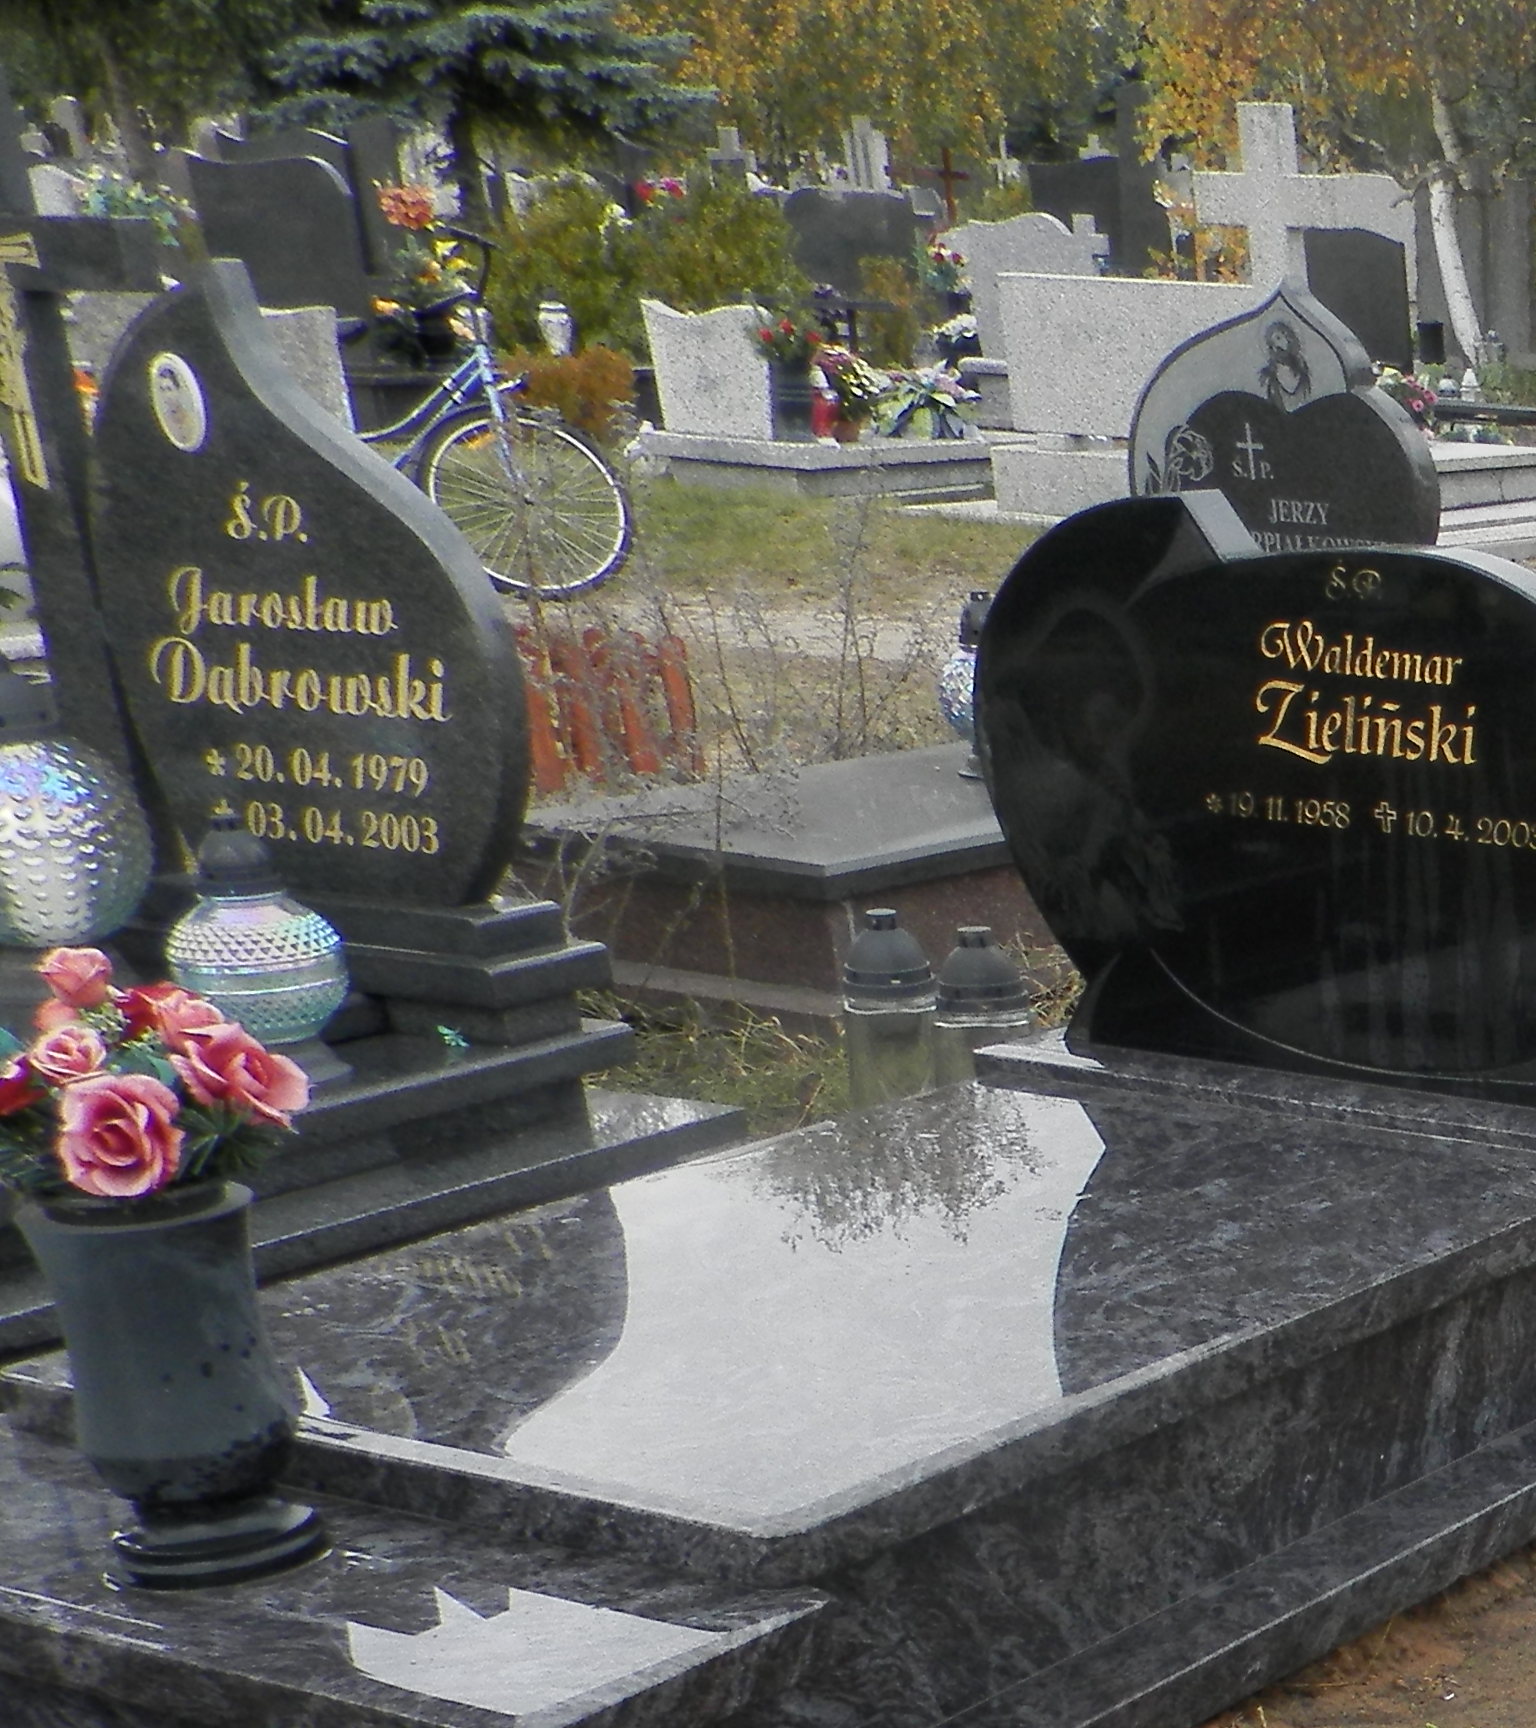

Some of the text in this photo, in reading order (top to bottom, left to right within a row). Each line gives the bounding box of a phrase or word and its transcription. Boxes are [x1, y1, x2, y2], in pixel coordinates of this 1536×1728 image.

[1268, 499, 1330, 526] JERZY
[149, 636, 453, 723] Dąbrowski
[1261, 620, 1464, 686] Waldemar
[1256, 678, 1478, 766] Zieliński
